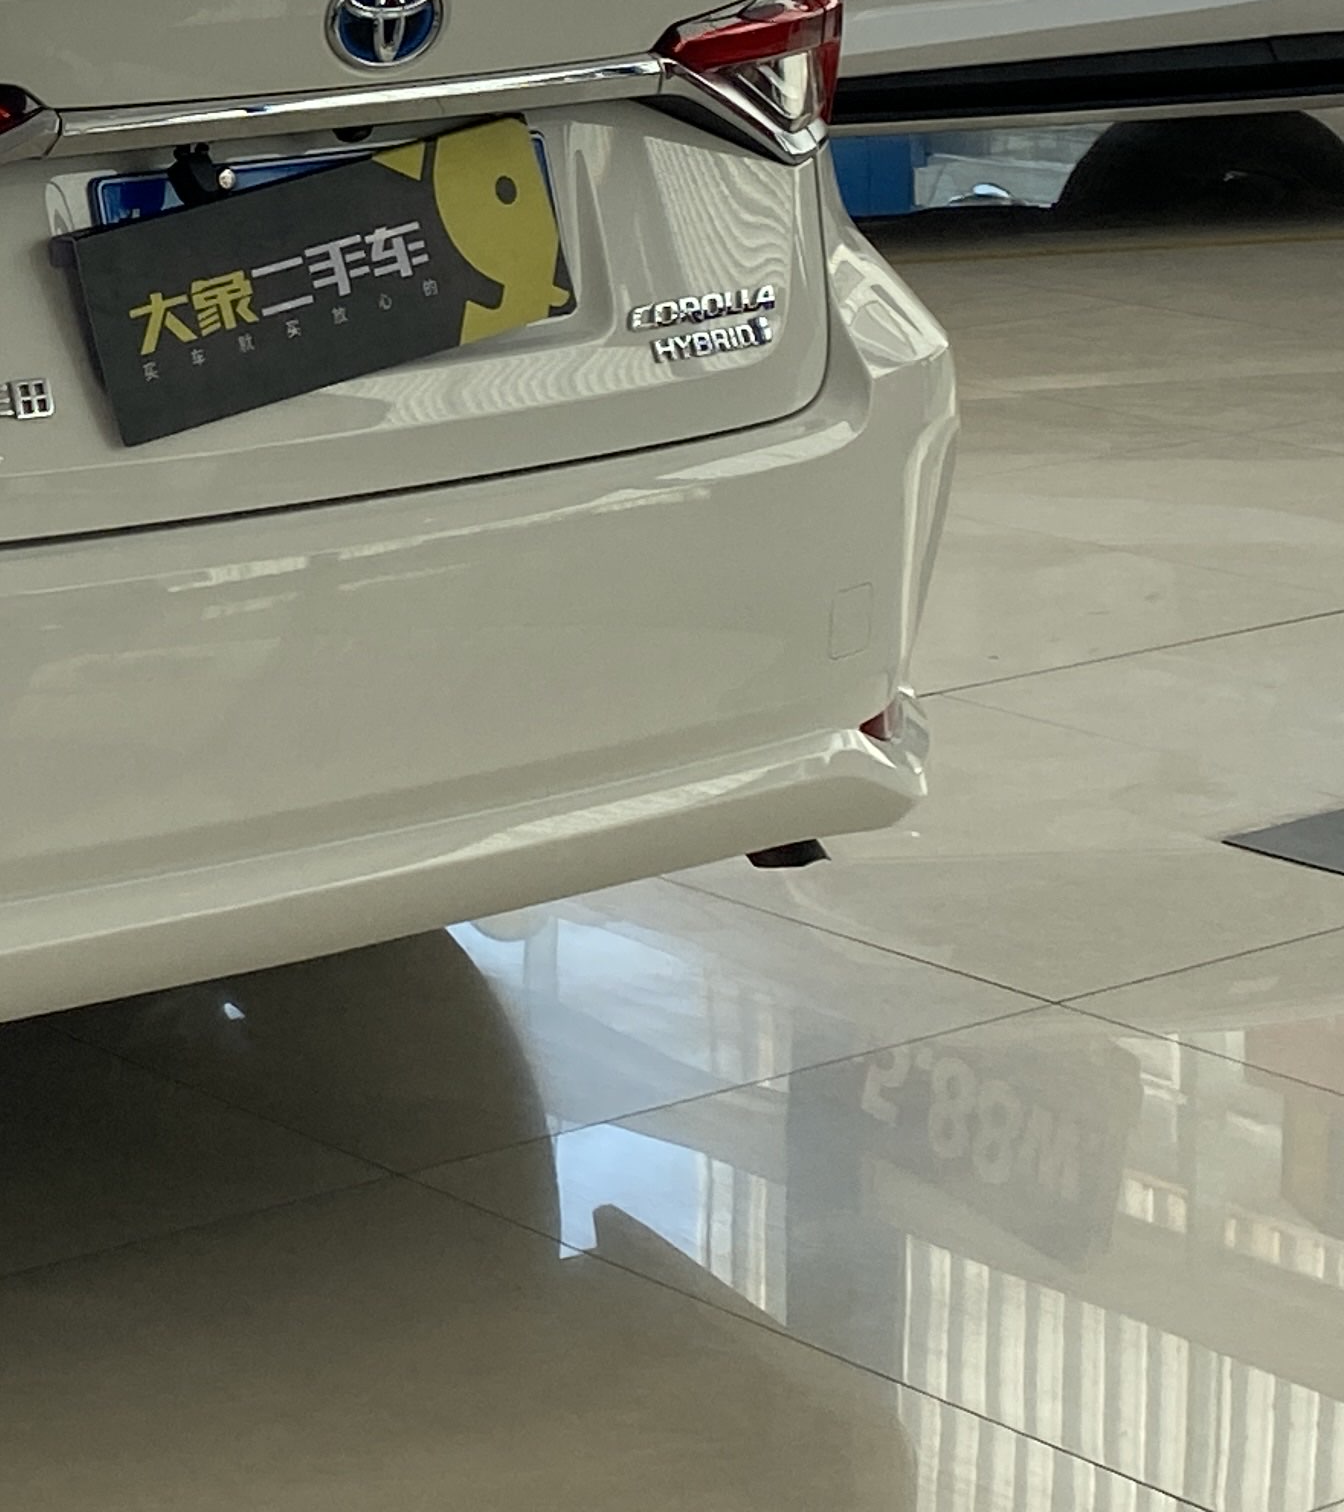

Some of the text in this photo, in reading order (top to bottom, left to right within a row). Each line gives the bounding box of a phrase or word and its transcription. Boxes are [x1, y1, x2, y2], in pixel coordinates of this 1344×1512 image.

[129, 220, 430, 356] 大象二手车
[627, 285, 777, 332] COROLLA
[142, 278, 440, 382] 买车就买放心的
[651, 323, 758, 363] HYBRID
